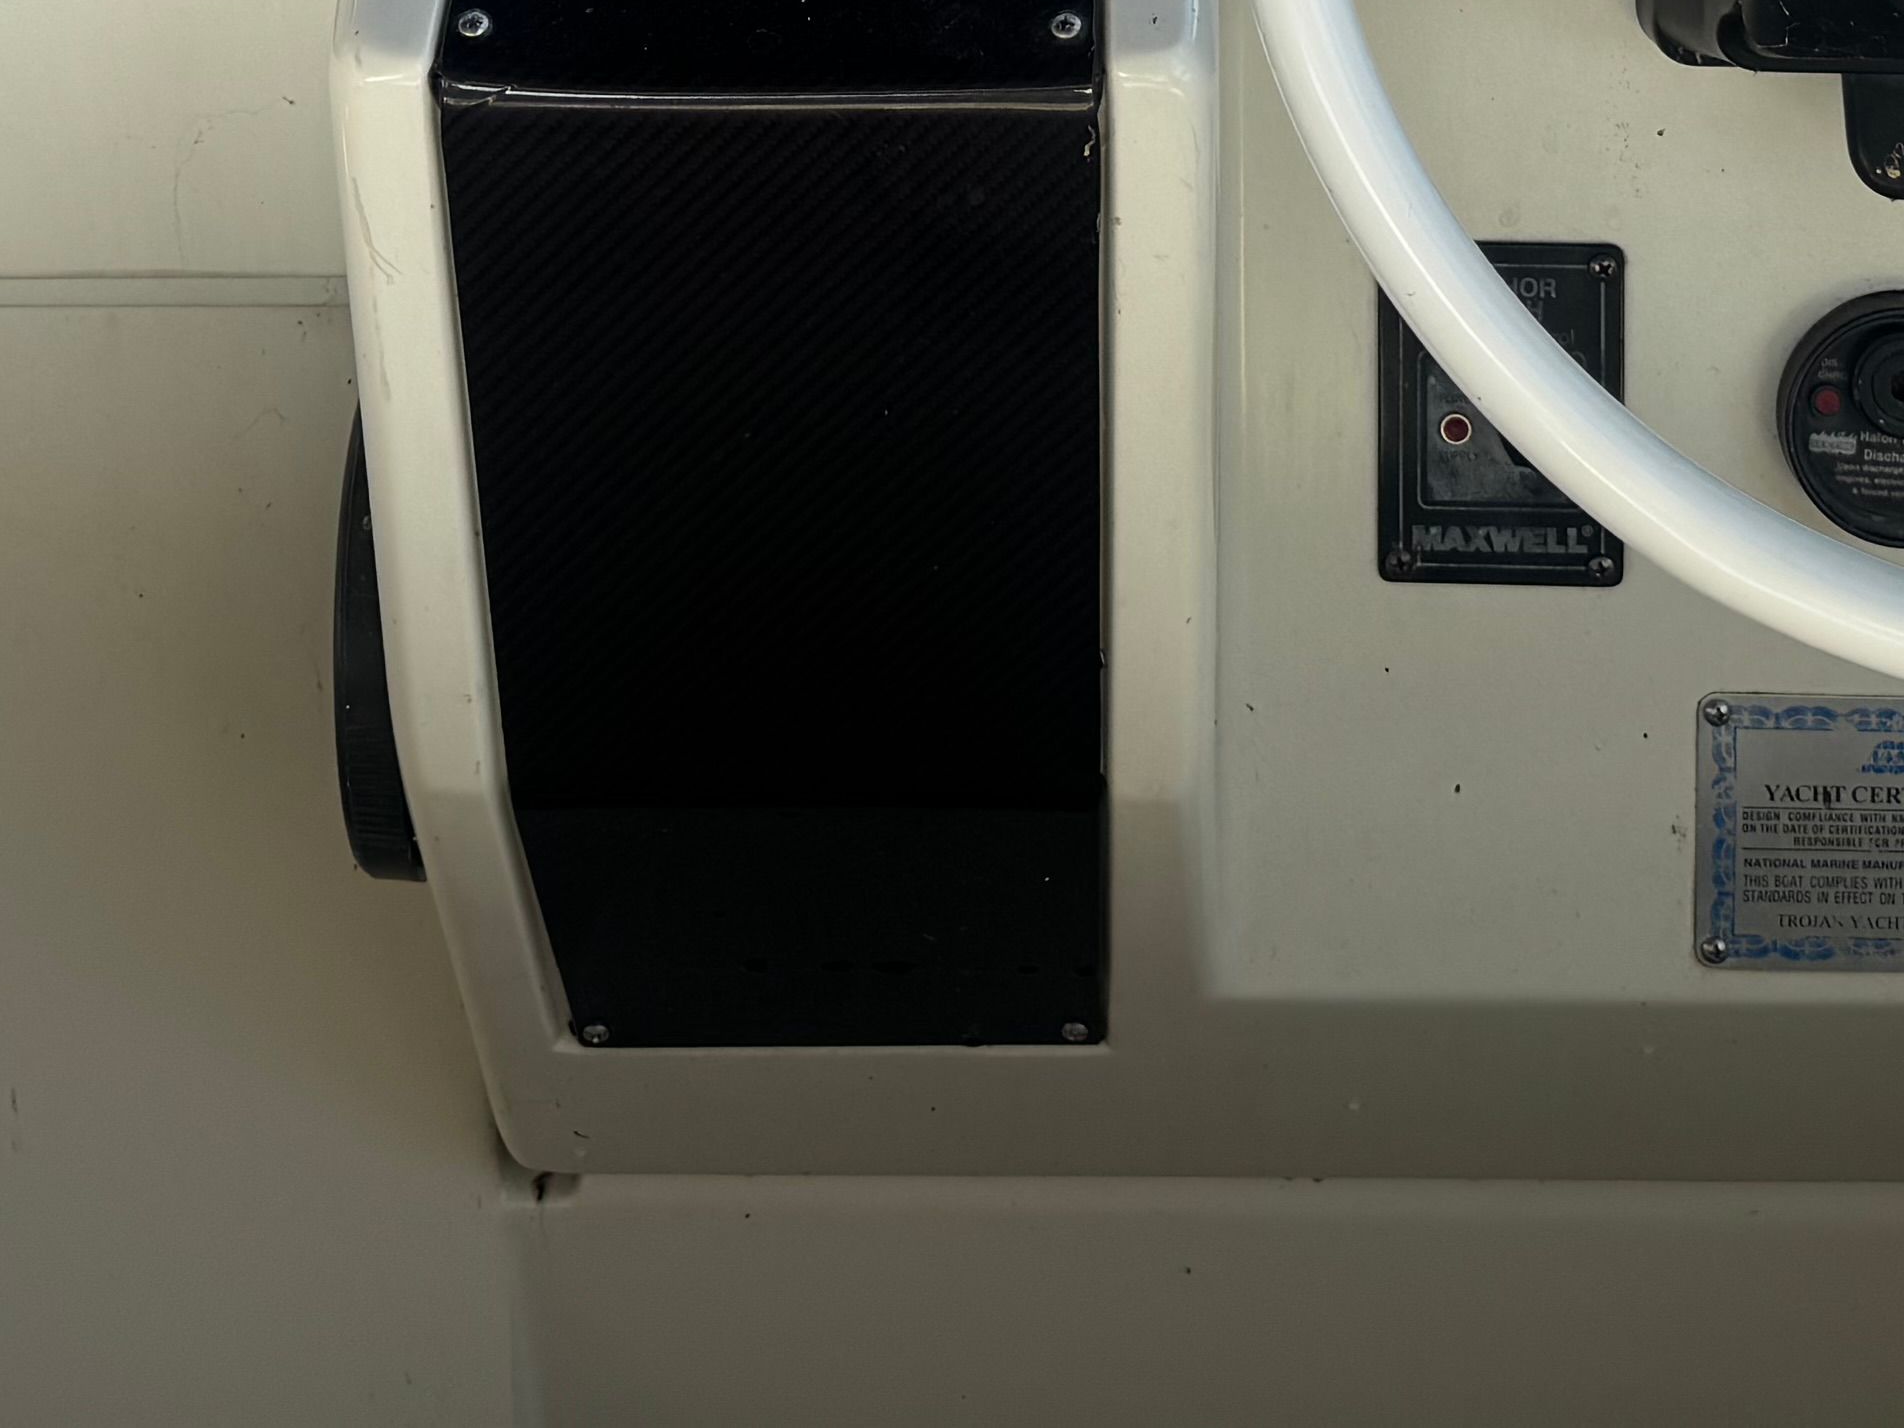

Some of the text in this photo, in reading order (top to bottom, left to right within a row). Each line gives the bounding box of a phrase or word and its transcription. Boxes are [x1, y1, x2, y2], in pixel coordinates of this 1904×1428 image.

[1859, 431, 1899, 446] Halon
[1412, 524, 1588, 554] MAXWELL
[1764, 783, 1847, 803] YACHT
[1742, 811, 1781, 822] DESIGN
[1788, 811, 1854, 823] COMPLIANCE
[1860, 812, 1886, 823] WITH
[1742, 823, 1757, 834] ON
[1760, 824, 1778, 834] THE
[1782, 824, 1808, 835] DATE
[1811, 824, 1826, 835] OF
[1828, 825, 1904, 836] CERTIFICATION
[1793, 836, 1864, 848] RESPONSIBLE
[1743, 858, 1807, 869] NATIONAL
[1810, 859, 1859, 870] MARINE
[1743, 874, 1769, 889] THIS
[1774, 875, 1804, 889] BOAT
[1810, 876, 1869, 890] COMPLIES
[1873, 877, 1903, 890] WITH
[1742, 889, 1812, 904] STANDARDS
[1816, 891, 1830, 904] IN
[1834, 891, 1873, 905] EFFECT
[1879, 892, 1896, 906] ON
